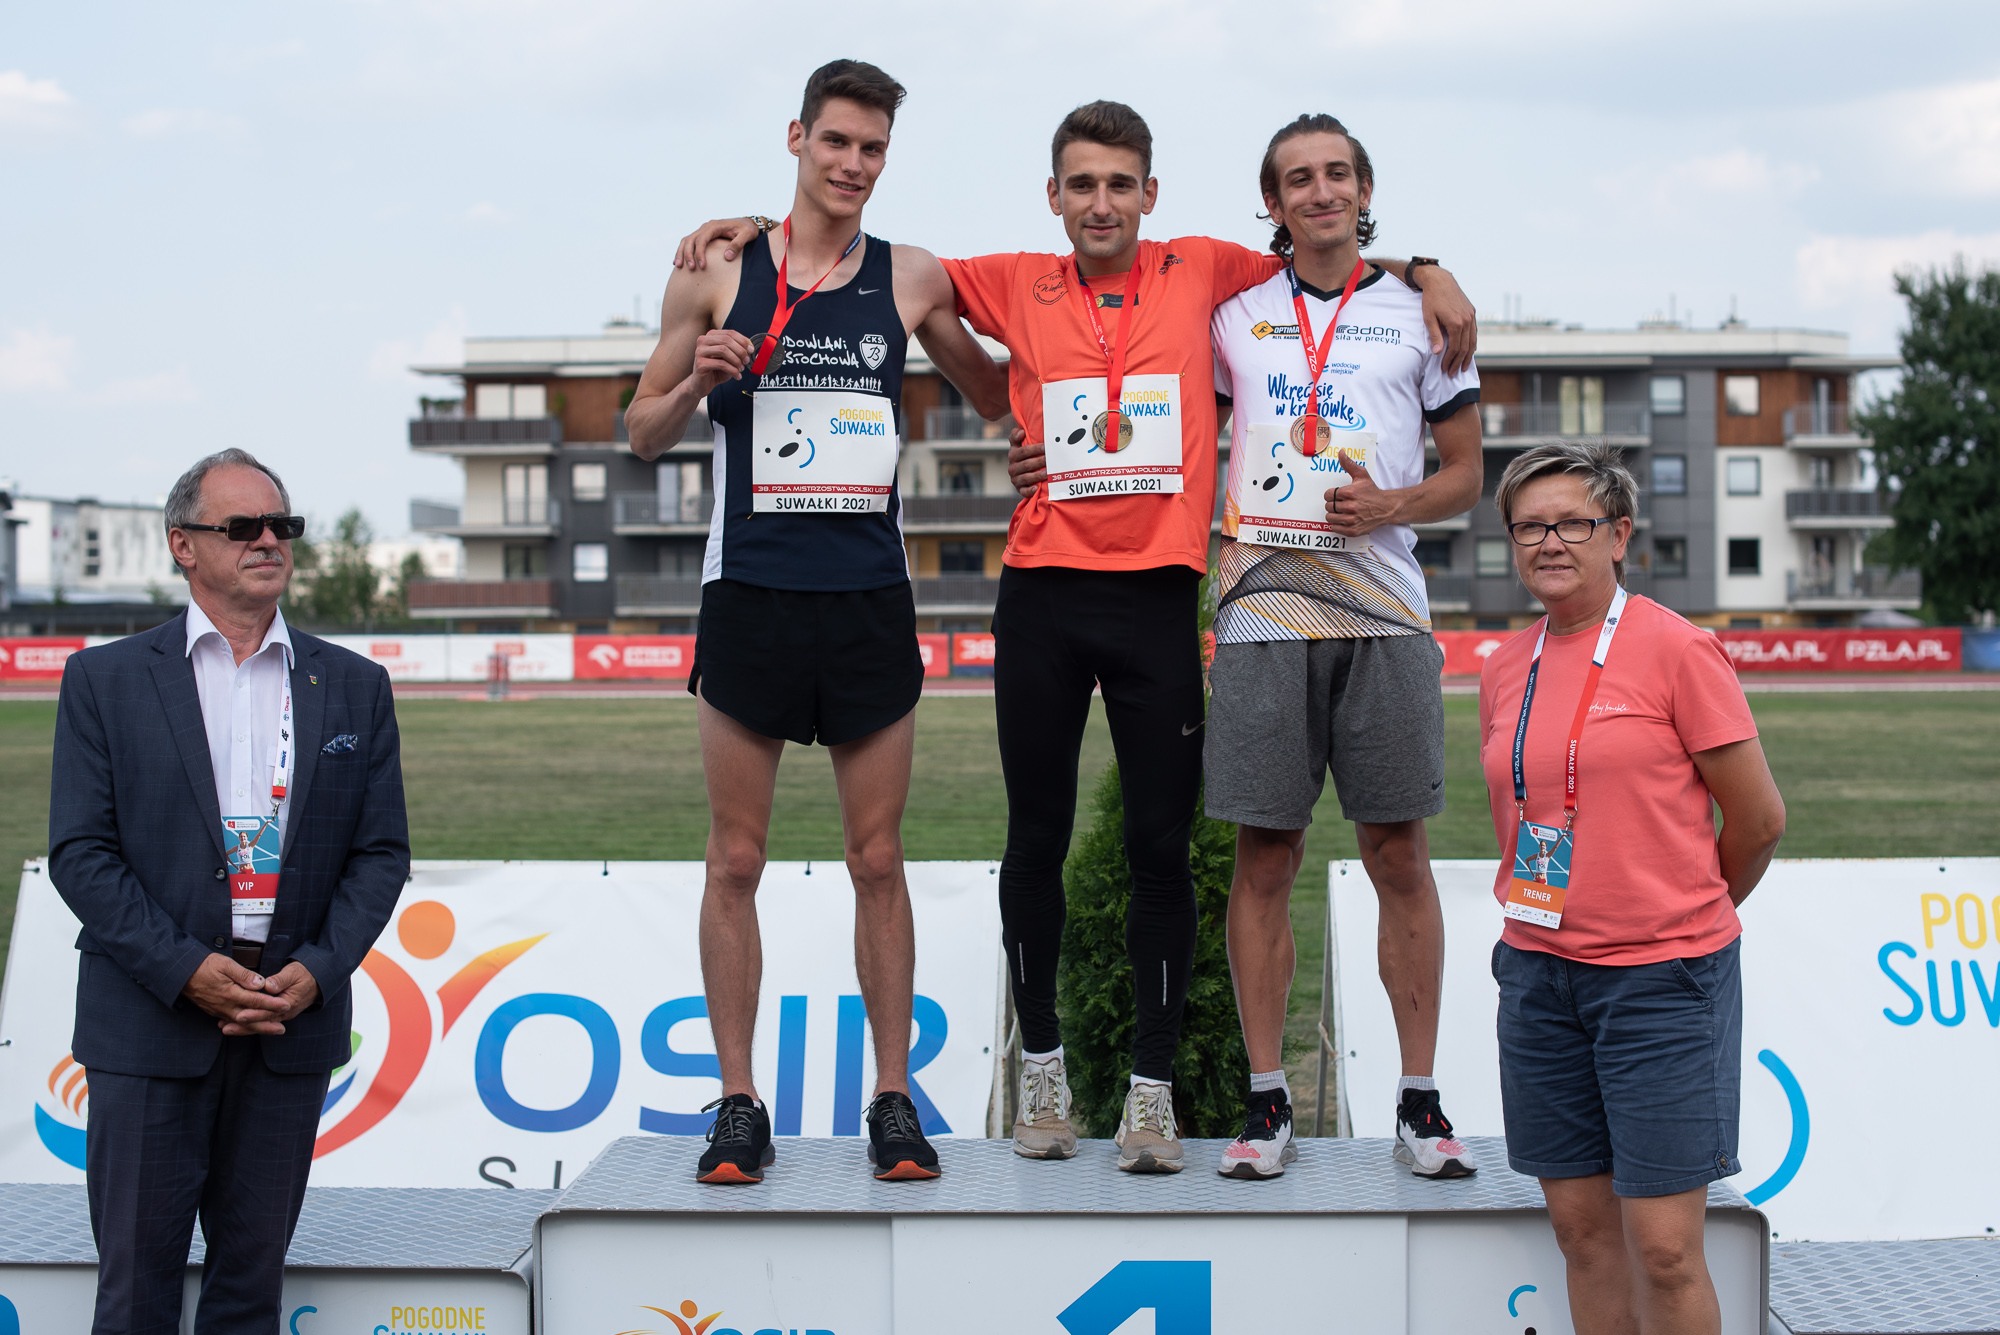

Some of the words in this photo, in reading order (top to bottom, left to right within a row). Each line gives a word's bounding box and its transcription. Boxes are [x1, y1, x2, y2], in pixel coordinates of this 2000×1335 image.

[1273, 325, 1300, 334] OPTIMA
[865, 336, 883, 344] CKS
[1365, 336, 1401, 346] precyzji
[1123, 390, 1169, 403] POGODNE
[1315, 382, 1334, 400] się
[839, 408, 884, 422] POGODNE
[1275, 402, 1286, 416] w
[1289, 394, 1355, 425] krówkę
[829, 417, 885, 437] SUWAŁKI
[1319, 446, 1367, 461] POGDNE
[1083, 468, 1137, 477] MISTRZOSTWA
[792, 485, 848, 493] MISTRZOSTWA
[1068, 479, 1128, 497] SUWAŁKI
[1132, 479, 1162, 491] 2021
[775, 497, 838, 510] SUWAŁKI
[841, 497, 872, 511] 2021
[1270, 520, 1323, 530] MISTRZOSTWA
[1256, 530, 1311, 547] SUWAŁKI
[1314, 535, 1347, 550] 2021
[1845, 639, 1952, 662] PZLA.PL
[1515, 707, 1529, 754] MISTRZOSTWA
[1567, 739, 1578, 774] SUWAŁKI
[1567, 775, 1575, 794] 2021
[237, 881, 254, 891] VIP
[1522, 887, 1552, 903] TRENER
[1920, 892, 2000, 950] PO
[474, 992, 954, 1138] OSIR
[391, 1306, 486, 1330] POGODNE
